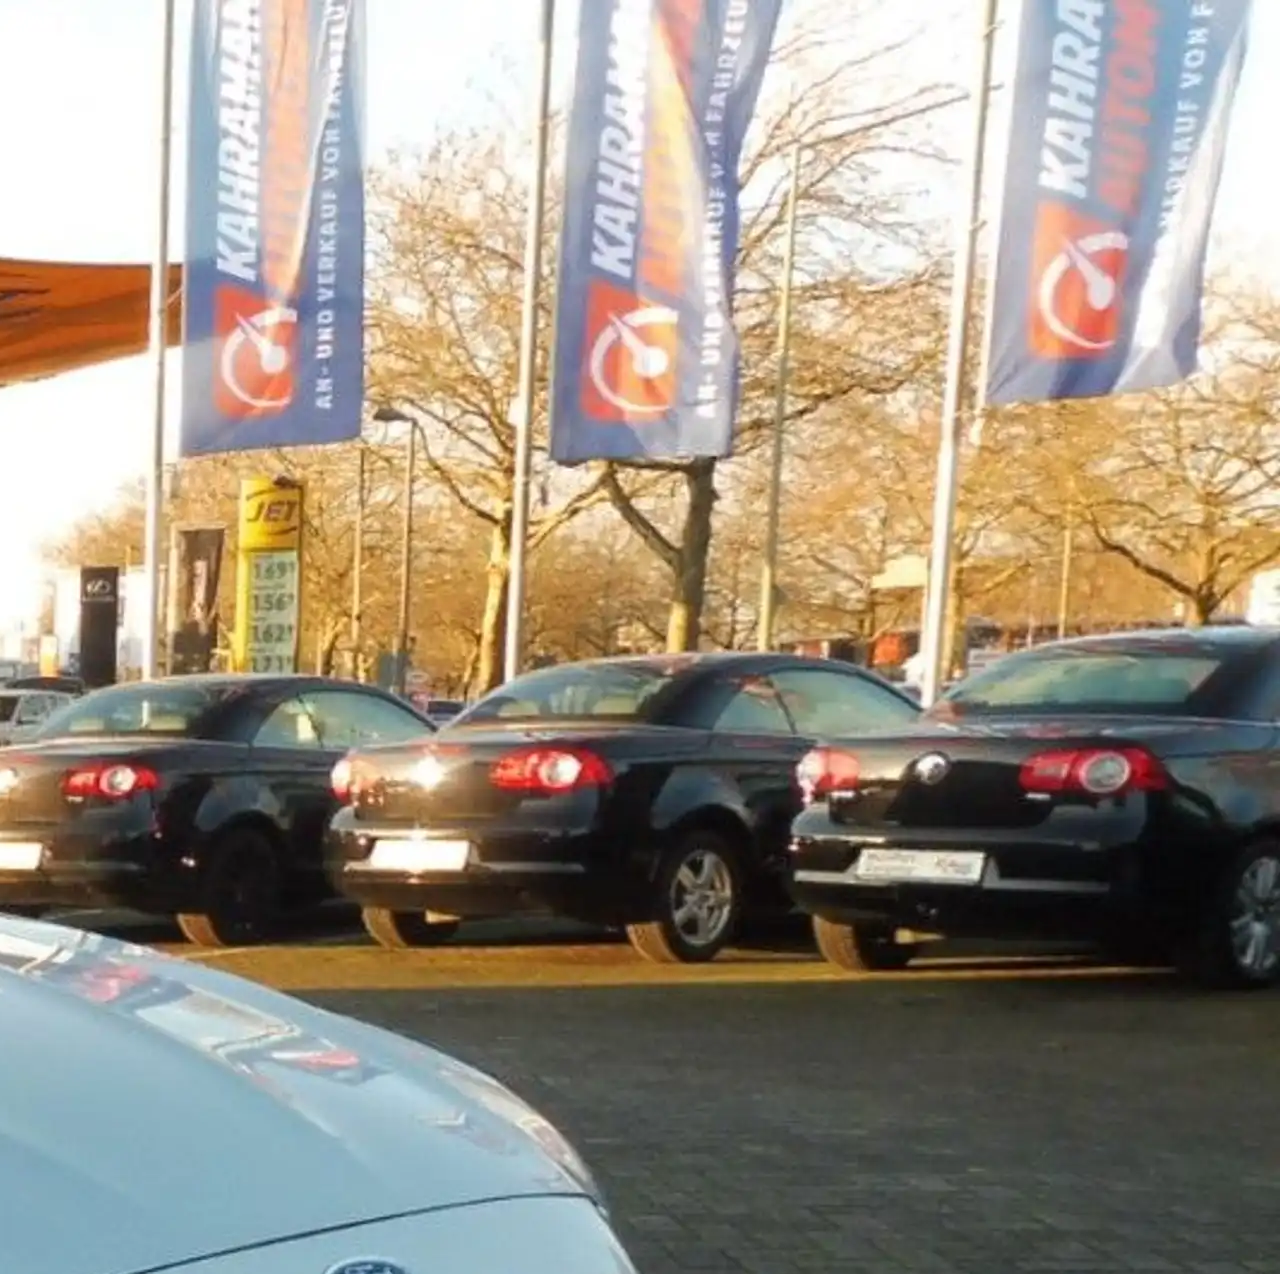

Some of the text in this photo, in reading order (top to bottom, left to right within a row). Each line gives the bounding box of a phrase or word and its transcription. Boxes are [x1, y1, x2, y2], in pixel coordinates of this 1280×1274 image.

[1180, 27, 1209, 89] VON
[317, 189, 339, 301] VERKAUF
[316, 309, 335, 360] UND
[700, 311, 724, 366] UND
[245, 501, 299, 523] JET
